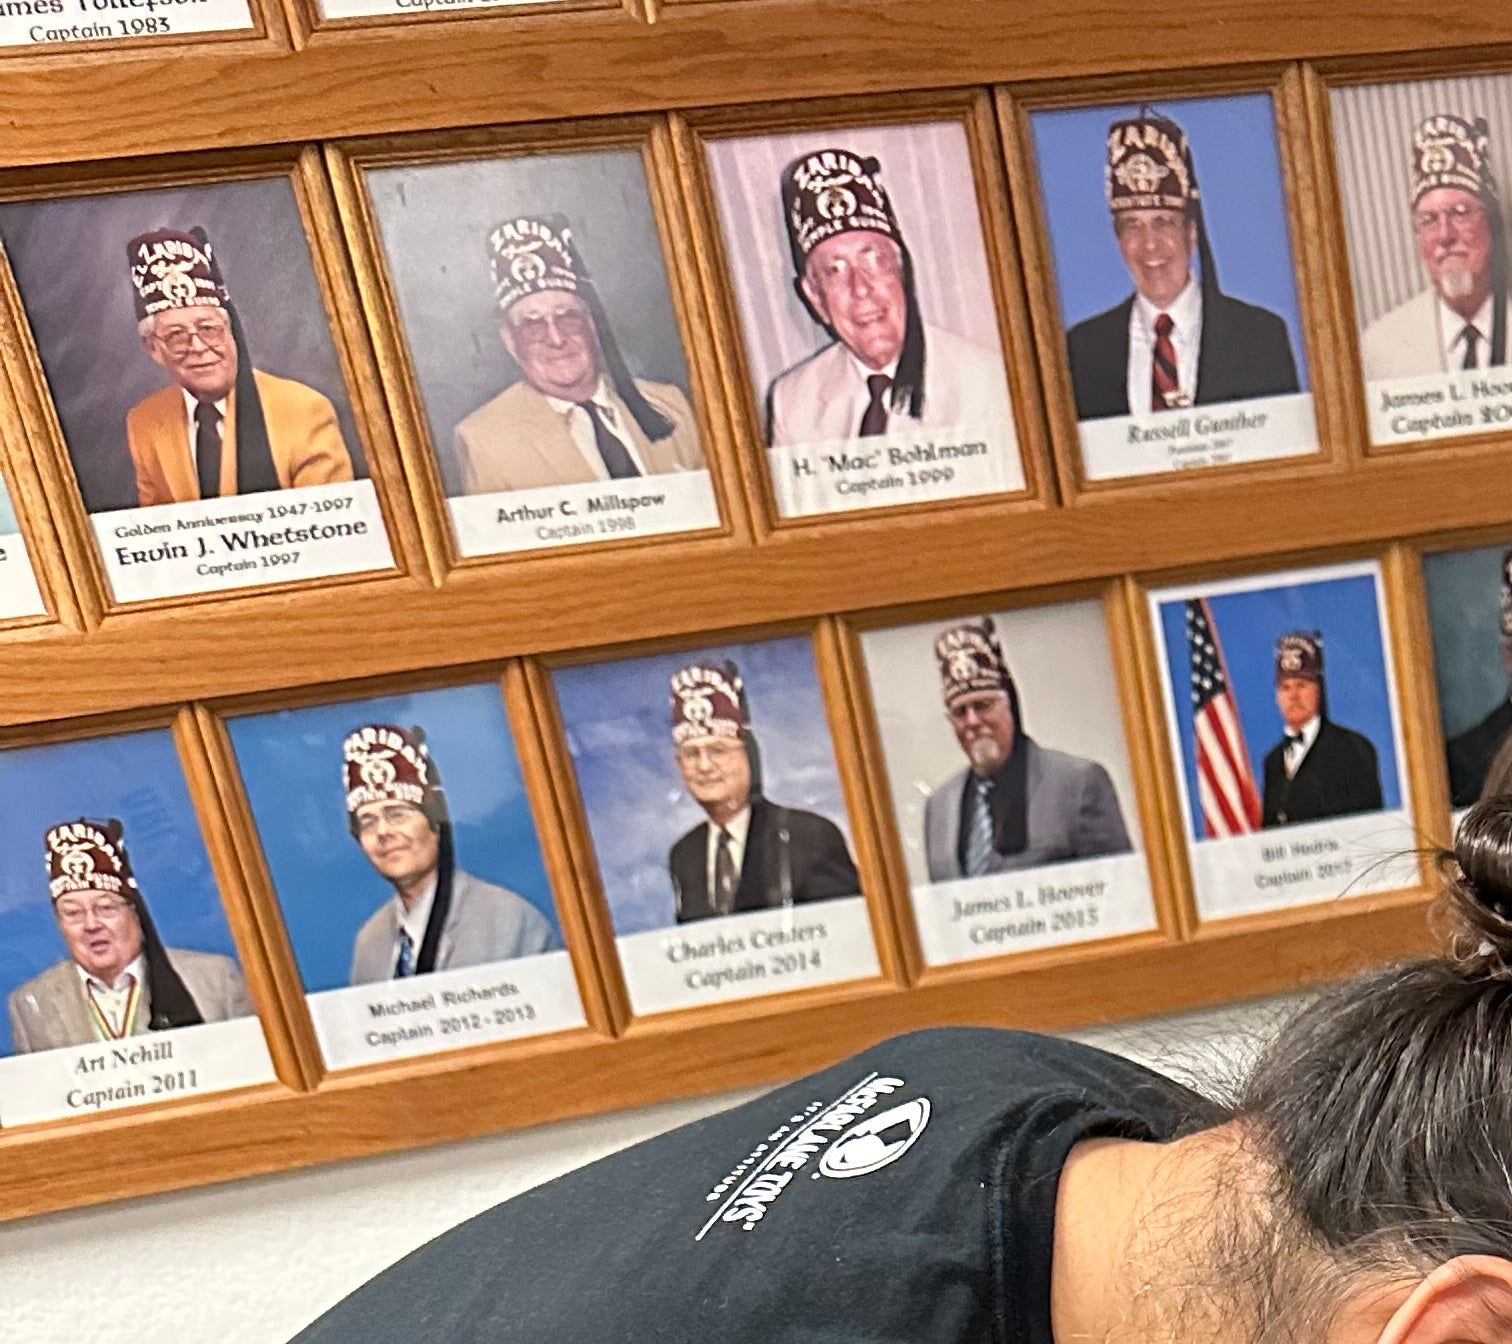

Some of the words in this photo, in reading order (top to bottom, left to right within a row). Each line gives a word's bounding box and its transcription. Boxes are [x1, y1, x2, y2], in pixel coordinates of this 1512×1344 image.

[29, 22, 112, 42] Captain
[118, 16, 171, 35] 1983
[1391, 410, 1474, 436] Captain
[835, 476, 905, 497] Captain
[908, 466, 955, 487] 1999
[267, 497, 354, 519] 1947-1997
[497, 503, 555, 524] Arthur
[197, 536, 216, 558] J.
[221, 519, 368, 552] Whetstone
[535, 522, 595, 541] Captain
[197, 557, 258, 577] Captain
[262, 551, 301, 568] 1997
[969, 917, 1046, 946] Captain
[667, 934, 746, 964] Charles
[685, 960, 767, 990] Captain
[368, 993, 436, 1019] Michael
[440, 982, 520, 1008] Richards
[365, 1024, 433, 1048] Captain
[75, 1055, 106, 1075] Art
[66, 1080, 146, 1110] Captain
[151, 1069, 199, 1095] 2011
